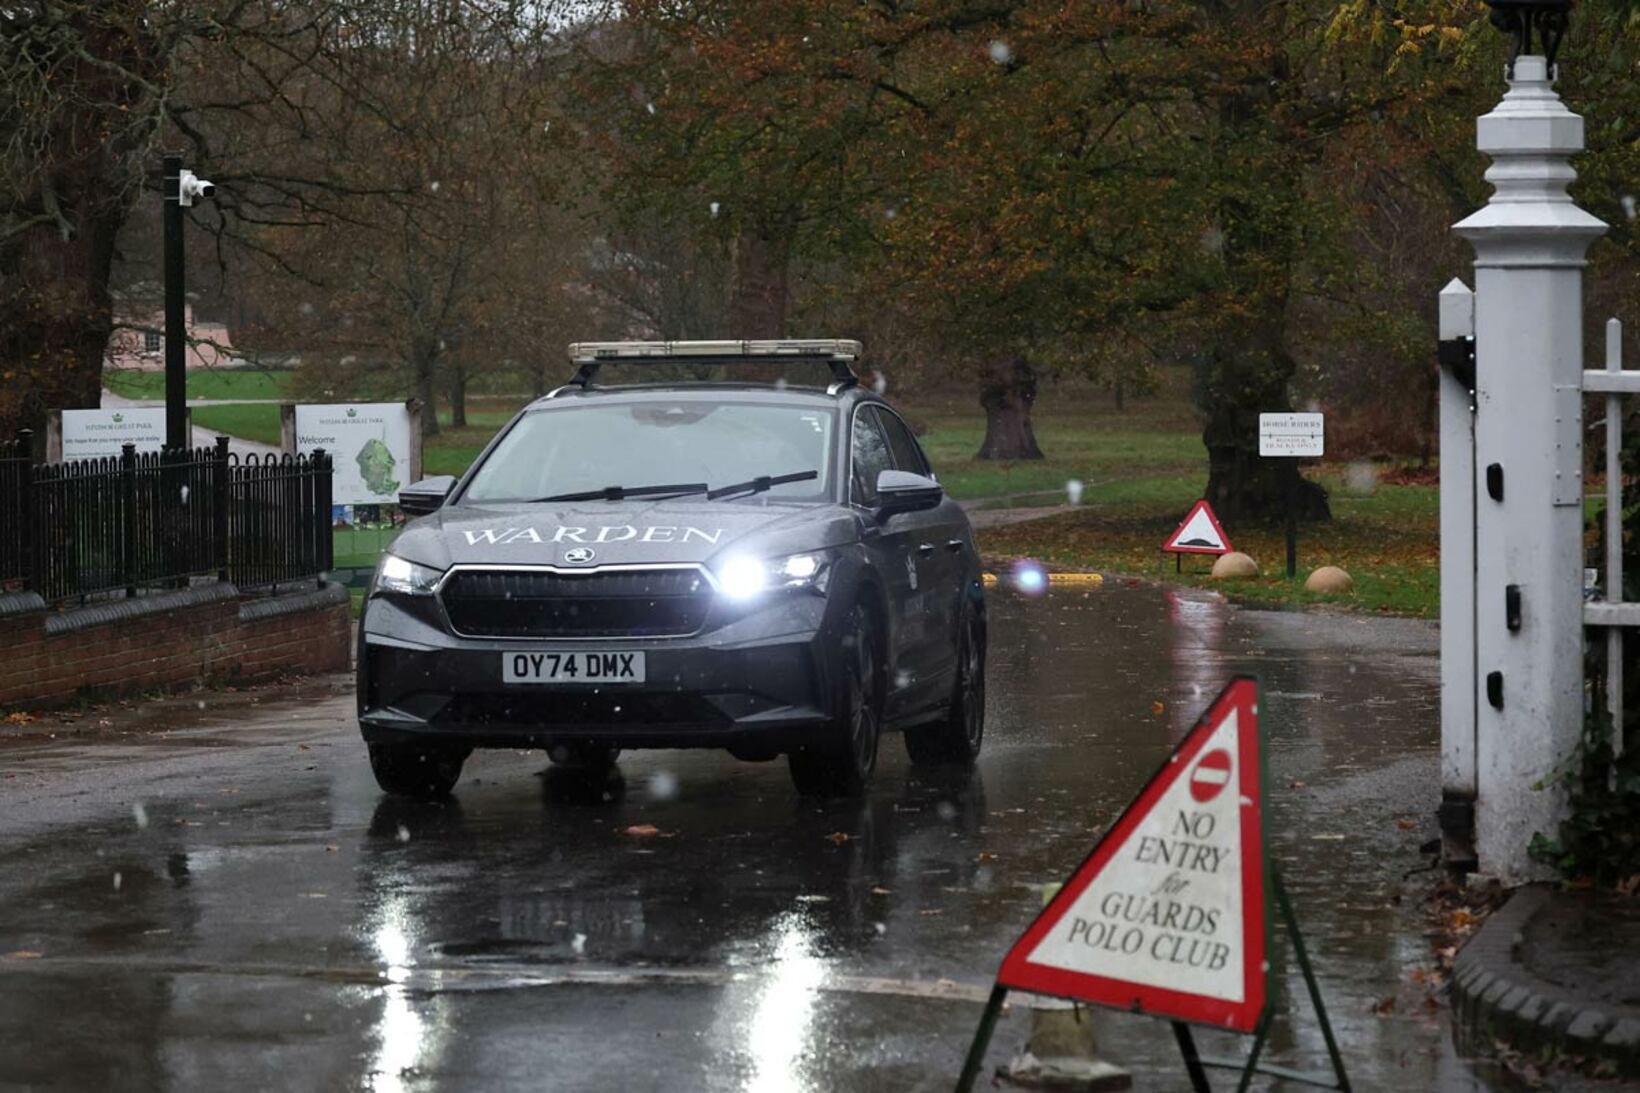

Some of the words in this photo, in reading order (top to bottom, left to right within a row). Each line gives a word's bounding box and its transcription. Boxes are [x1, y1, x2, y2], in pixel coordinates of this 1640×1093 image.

[298, 435, 335, 445] Welcome
[461, 524, 729, 547] WARDEN
[513, 654, 578, 678] OY74
[585, 654, 635, 678] DMX
[1171, 810, 1216, 840] NO
[1134, 836, 1231, 874] ENTRY
[1150, 870, 1191, 896] for
[1100, 891, 1222, 936] GUARDS
[1067, 917, 1145, 956] POLO
[1150, 933, 1231, 972] CLUB
